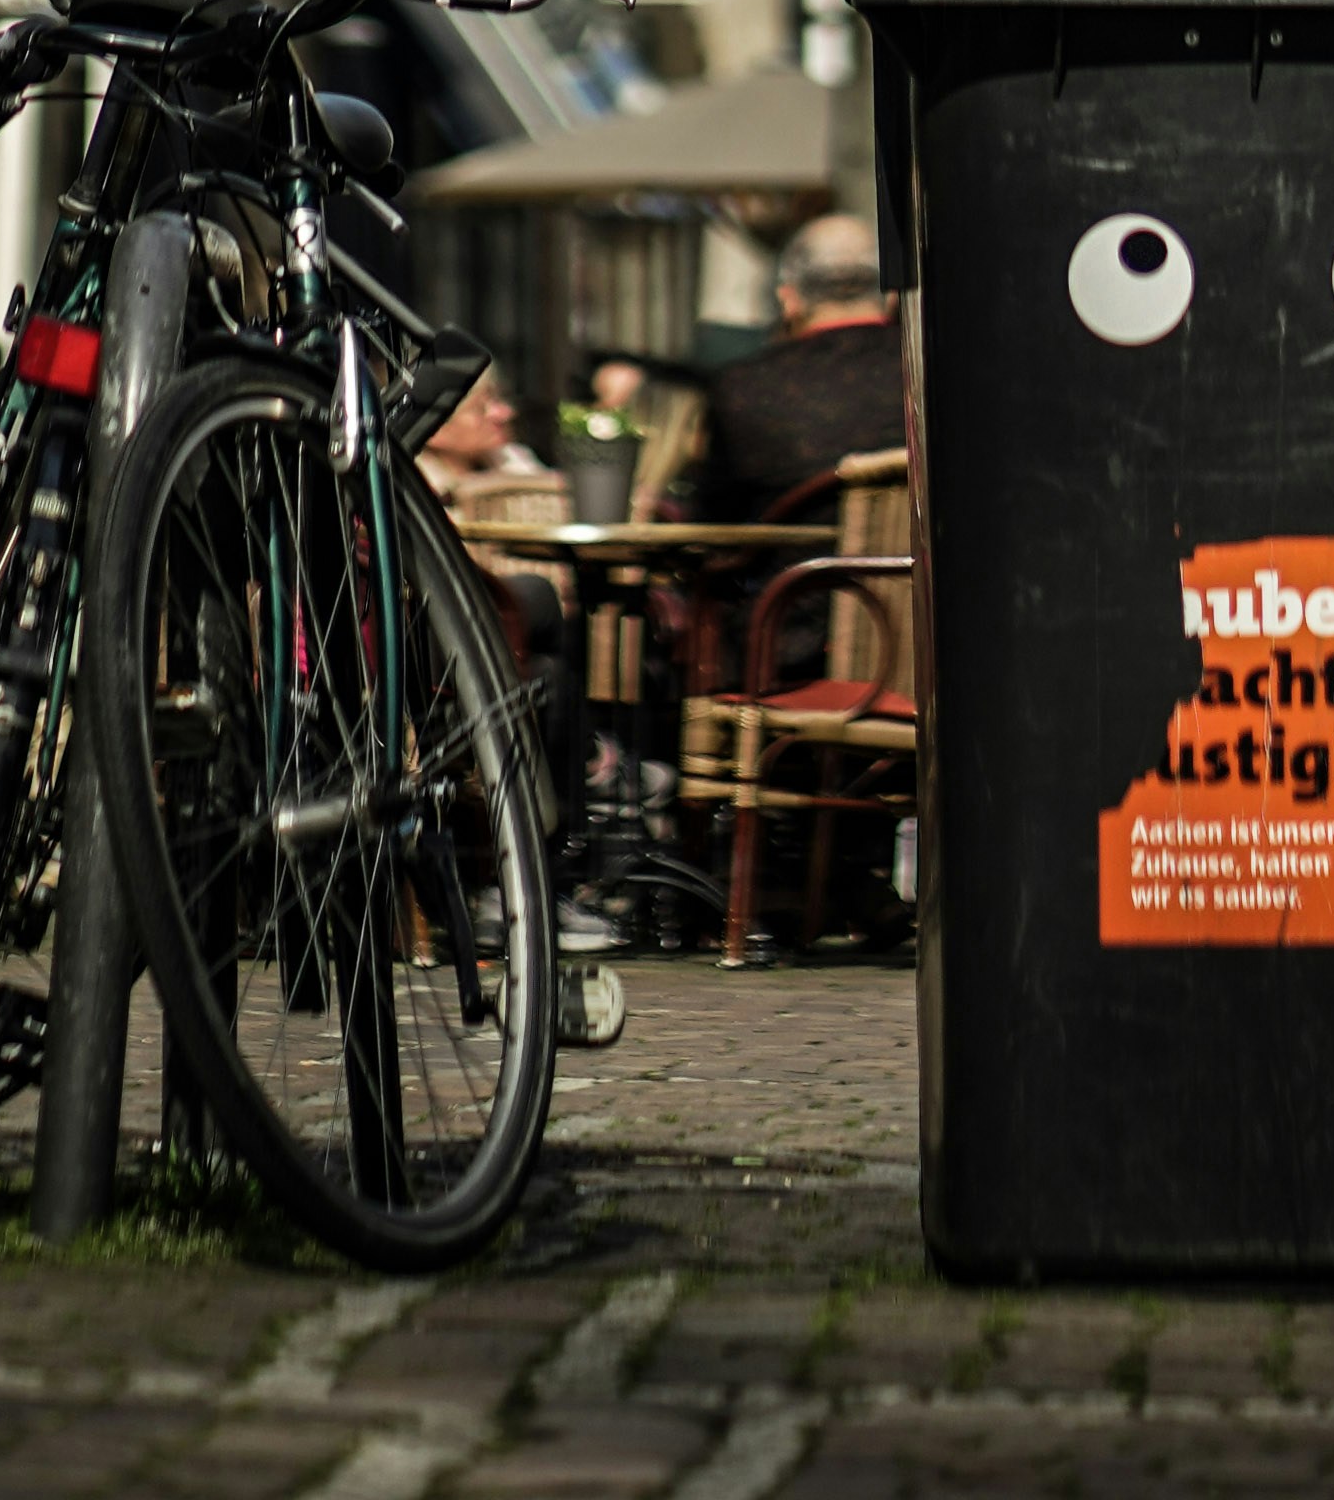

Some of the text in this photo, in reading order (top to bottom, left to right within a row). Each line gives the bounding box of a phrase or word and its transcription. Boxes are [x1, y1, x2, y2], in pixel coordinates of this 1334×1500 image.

[1131, 814, 1222, 846] Aachen
[1231, 814, 1260, 846] ist
[1131, 847, 1330, 881] Zuhause, halten
[1131, 880, 1170, 910] wir
[1179, 884, 1205, 911] es
